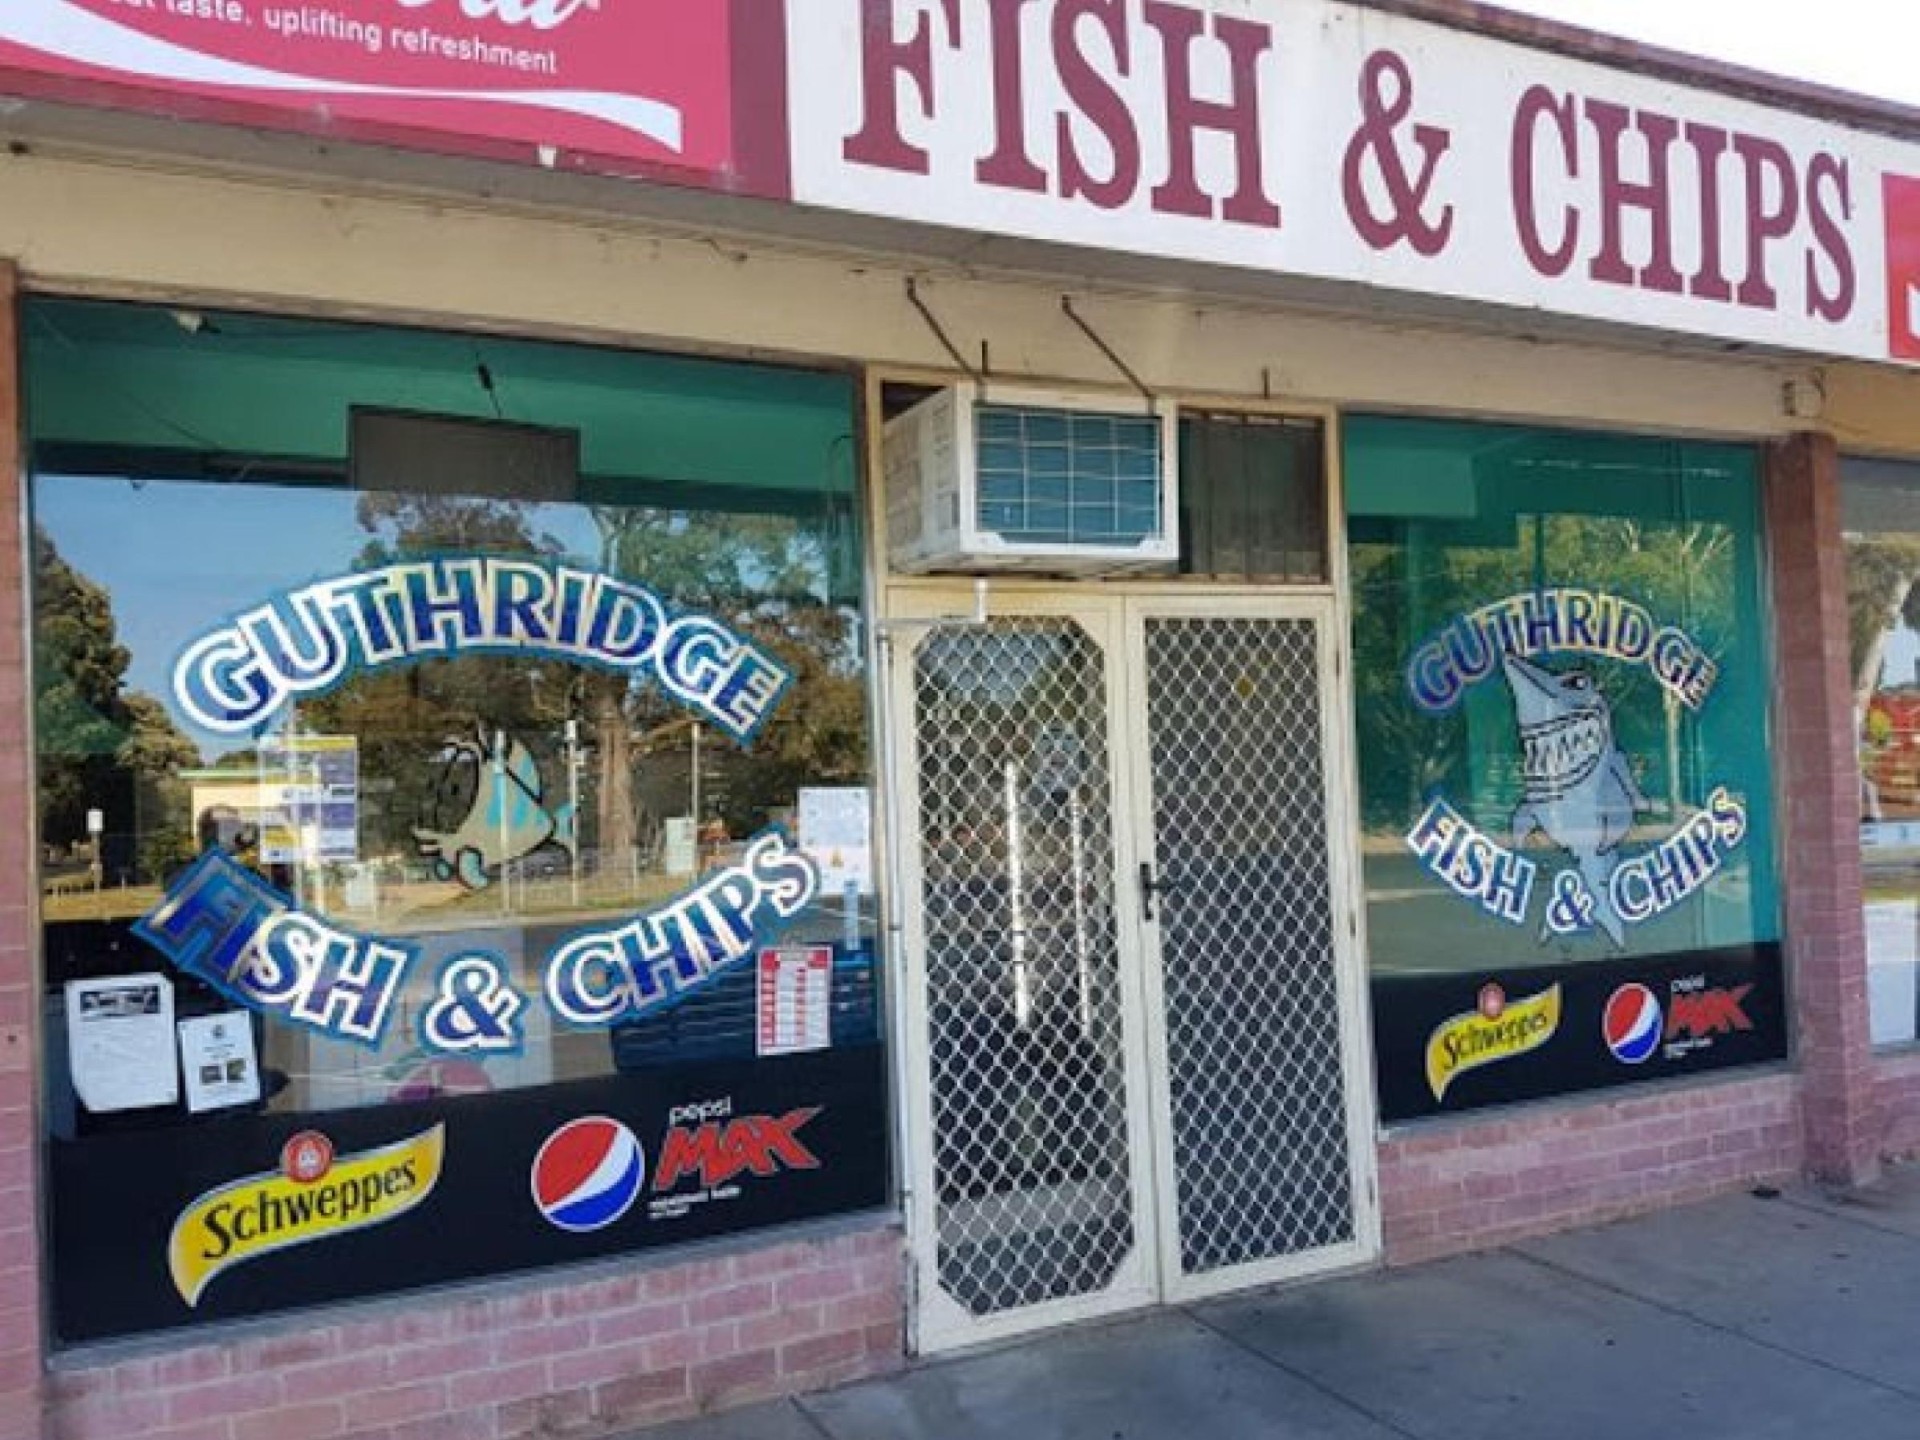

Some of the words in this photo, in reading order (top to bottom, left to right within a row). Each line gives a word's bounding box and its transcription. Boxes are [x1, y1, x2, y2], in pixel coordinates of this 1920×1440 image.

[263, 7, 382, 52] uplifting
[390, 28, 558, 74] refreshment
[842, 0, 1281, 228] FISH
[1341, 49, 1454, 256] &
[1510, 83, 1856, 323] CHIPS
[173, 558, 789, 735] GUTHRIDGE
[1408, 587, 1718, 710] GUTHRIDGE
[1407, 799, 1536, 924] FISH
[1546, 868, 1594, 932] &
[1609, 786, 1747, 920] CHIPS
[145, 862, 405, 1042] FISH
[426, 959, 521, 1048] &
[547, 832, 818, 1023] CHIPS
[202, 1157, 416, 1260] Schweppes
[653, 1104, 824, 1190] MAX
